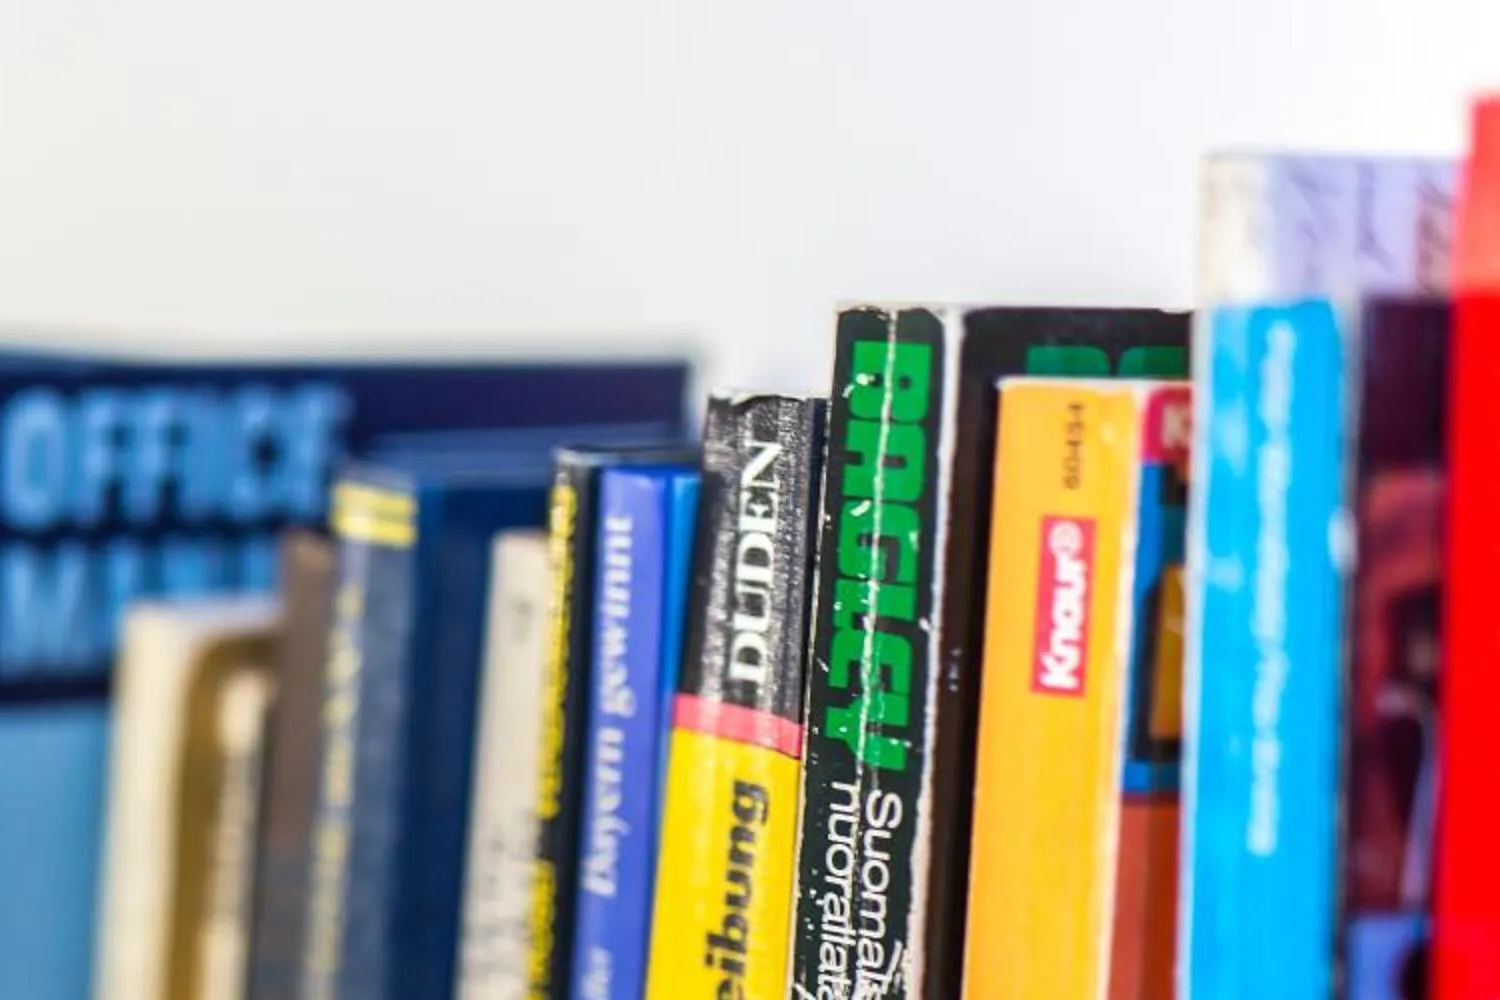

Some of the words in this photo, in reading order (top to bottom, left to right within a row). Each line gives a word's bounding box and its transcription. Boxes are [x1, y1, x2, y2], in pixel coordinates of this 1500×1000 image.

[599, 515, 638, 719] gewinnt
[730, 439, 783, 682] DUDEN
[825, 340, 932, 770] BAGLEY
[580, 726, 633, 897] Bayern
